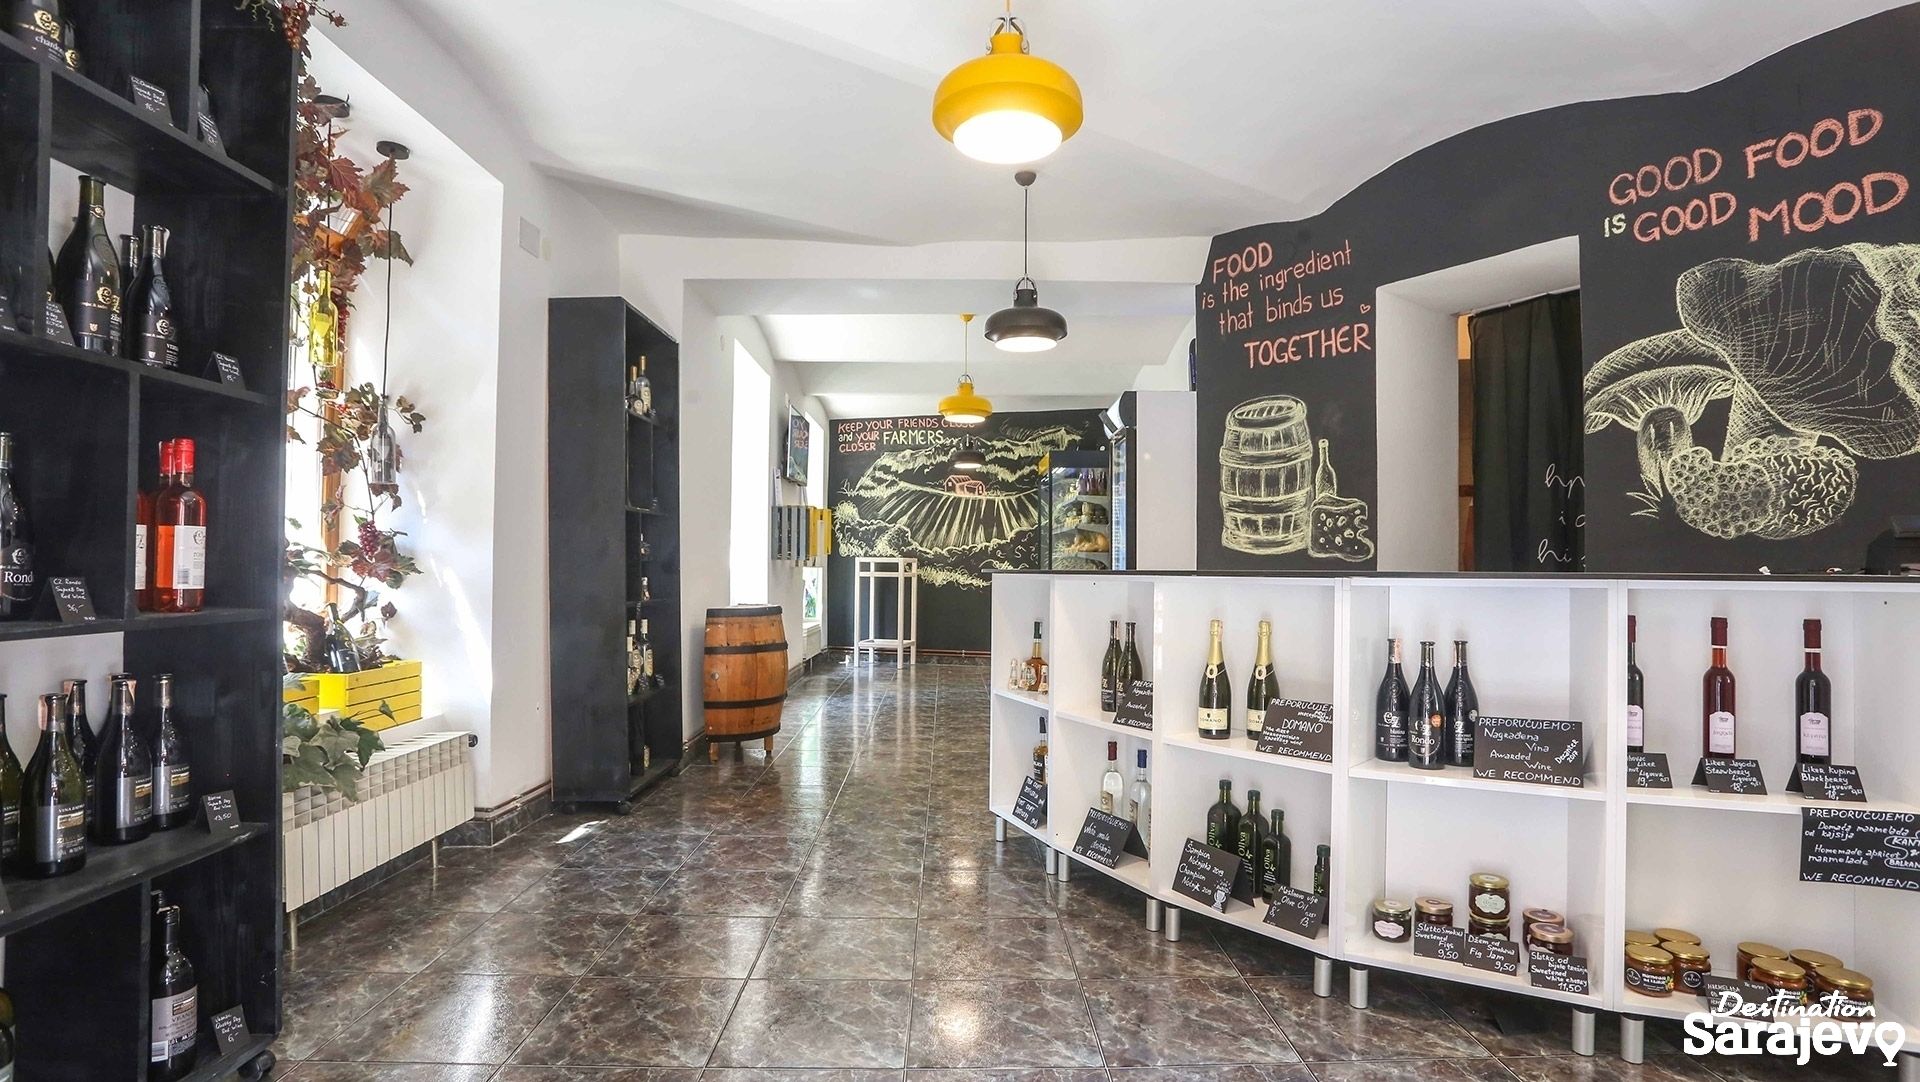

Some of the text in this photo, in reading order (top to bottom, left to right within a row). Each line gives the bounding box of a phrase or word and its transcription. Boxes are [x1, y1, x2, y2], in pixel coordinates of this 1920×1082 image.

[1609, 108, 1883, 206] GOOD FOOD
[1604, 171, 1910, 243] IS GOOD MOOD
[1212, 242, 1273, 284] FOOD
[1202, 239, 1352, 310] is the ingredient
[1219, 283, 1344, 336] that binds us
[1243, 322, 1372, 369] TOGETHER
[837, 421, 864, 434] KEEP
[865, 419, 893, 431] YOUR
[898, 418, 939, 429] FRIENDS
[838, 429, 945, 445] and YOUR FARMERS
[839, 442, 877, 453] CLOSER
[1282, 718, 1324, 734] DOMANO
[1478, 716, 1576, 732] PREPORUČUJEMO:
[1411, 734, 1435, 745] Rondo
[1258, 744, 1332, 761] WE RECOMMEND
[1525, 742, 1550, 753] Vina
[1489, 749, 1532, 761] Awarded
[1705, 758, 1726, 766] Liker
[1524, 760, 1553, 771] Wine
[1705, 766, 1751, 778] Strawberry
[1802, 763, 1856, 777] Liker Kupina
[1476, 769, 1581, 786] WE RECOMMEND
[1801, 772, 1849, 786] Blackberry
[1809, 808, 1915, 823] PREPORUČUJEMO
[1856, 826, 1910, 837] marmelada
[1814, 844, 1863, 856] Homemade
[1808, 855, 1869, 866] marmelade
[1802, 872, 1920, 890] WE RECOMMEND
[1297, 901, 1309, 912] Oil
[1417, 922, 1442, 934] Slatko
[1437, 949, 1459, 960] 9,50
[1469, 947, 1505, 961] Fig Jam
[1531, 951, 1569, 965] Slatko od
[1494, 961, 1516, 972] 9,50
[1557, 982, 1582, 993] 11,50
